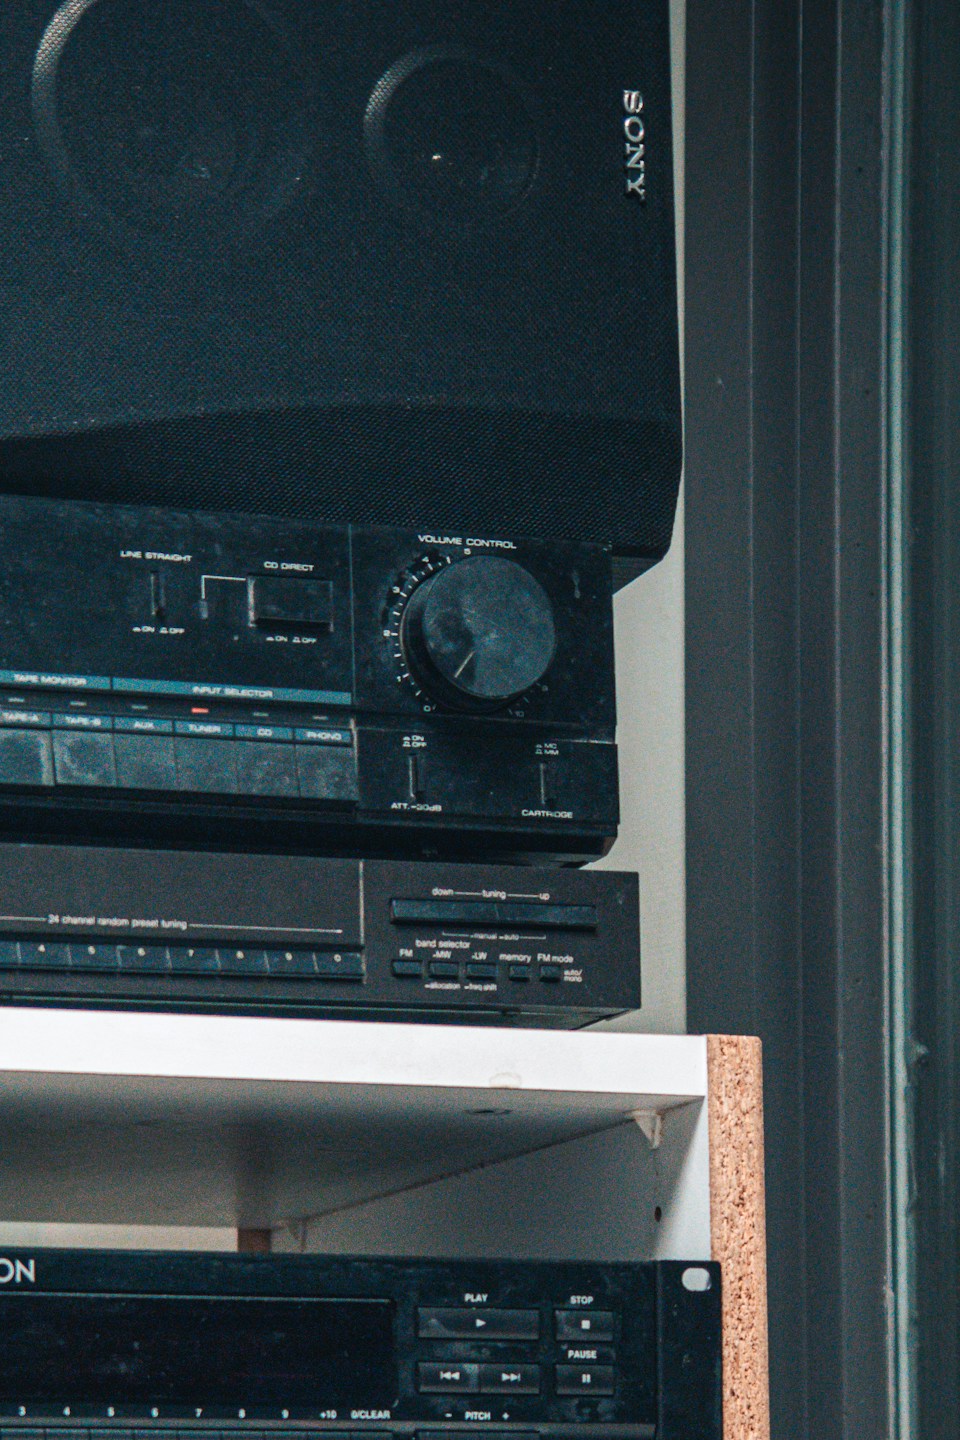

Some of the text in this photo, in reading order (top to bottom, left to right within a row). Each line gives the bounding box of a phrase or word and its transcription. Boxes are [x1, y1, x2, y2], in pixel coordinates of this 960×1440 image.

[623, 90, 645, 200] SONY
[419, 535, 517, 549] VOLUME CONTROL
[120, 551, 192, 562] LINE STRAIGHT
[264, 561, 314, 572] CD DIRECT
[193, 686, 273, 697] INPUT SELECTOR
[521, 810, 573, 819] CARTRIDGE
[432, 888, 454, 896] down
[482, 890, 506, 900] tuning
[62, 915, 95, 925] channel
[97, 917, 129, 926] random
[132, 919, 158, 928] preset
[161, 920, 187, 930] tuning
[416, 939, 470, 949] band selector
[400, 949, 413, 957] FM
[500, 953, 531, 963] memory
[537, 953, 573, 963] FM mode
[465, 1293, 488, 1303] PLAY
[570, 1295, 593, 1304] STOP
[568, 1350, 597, 1359] PAUSE
[320, 1410, 336, 1419] +10
[465, 1411, 490, 1420] PITCH
